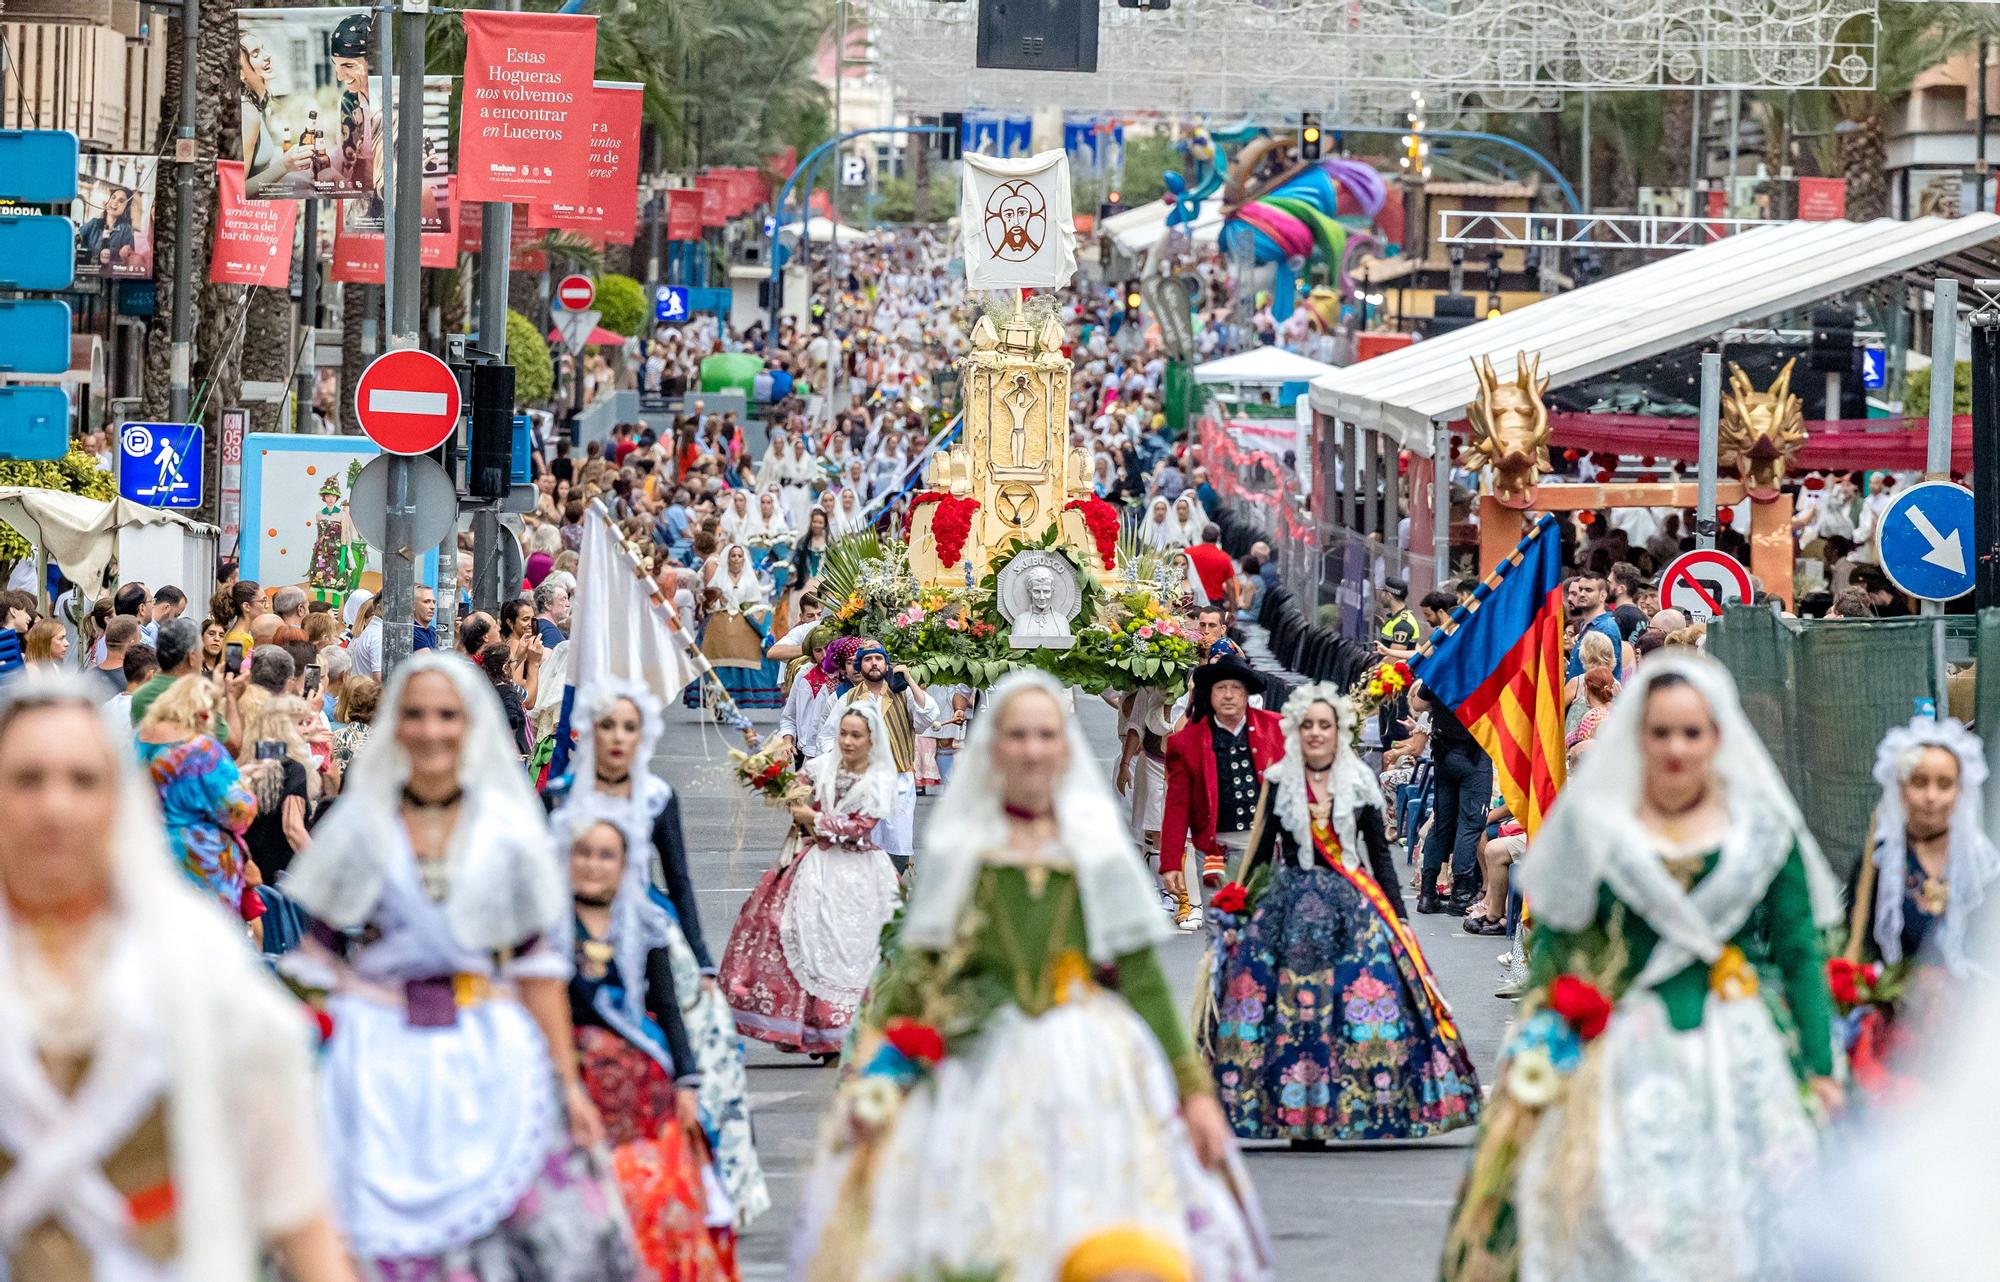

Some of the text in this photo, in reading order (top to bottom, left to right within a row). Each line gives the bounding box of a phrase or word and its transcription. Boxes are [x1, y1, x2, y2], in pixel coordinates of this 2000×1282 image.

[506, 47, 546, 64] Estas
[489, 65, 562, 86] Hogueras
[475, 85, 573, 103] nos volvemos
[480, 107, 568, 122] a encontrar
[482, 123, 562, 140] en Luceros
[600, 123, 608, 132] a
[589, 137, 621, 148] untos
[603, 150, 619, 163] de
[490, 163, 516, 172] Mahou
[0, 206, 42, 217] DIODIA
[225, 207, 278, 221] arriba en la
[224, 220, 276, 232] terraza del
[221, 228, 279, 245] bar de abajo
[223, 430, 241, 445] 05
[222, 445, 241, 461] 39
